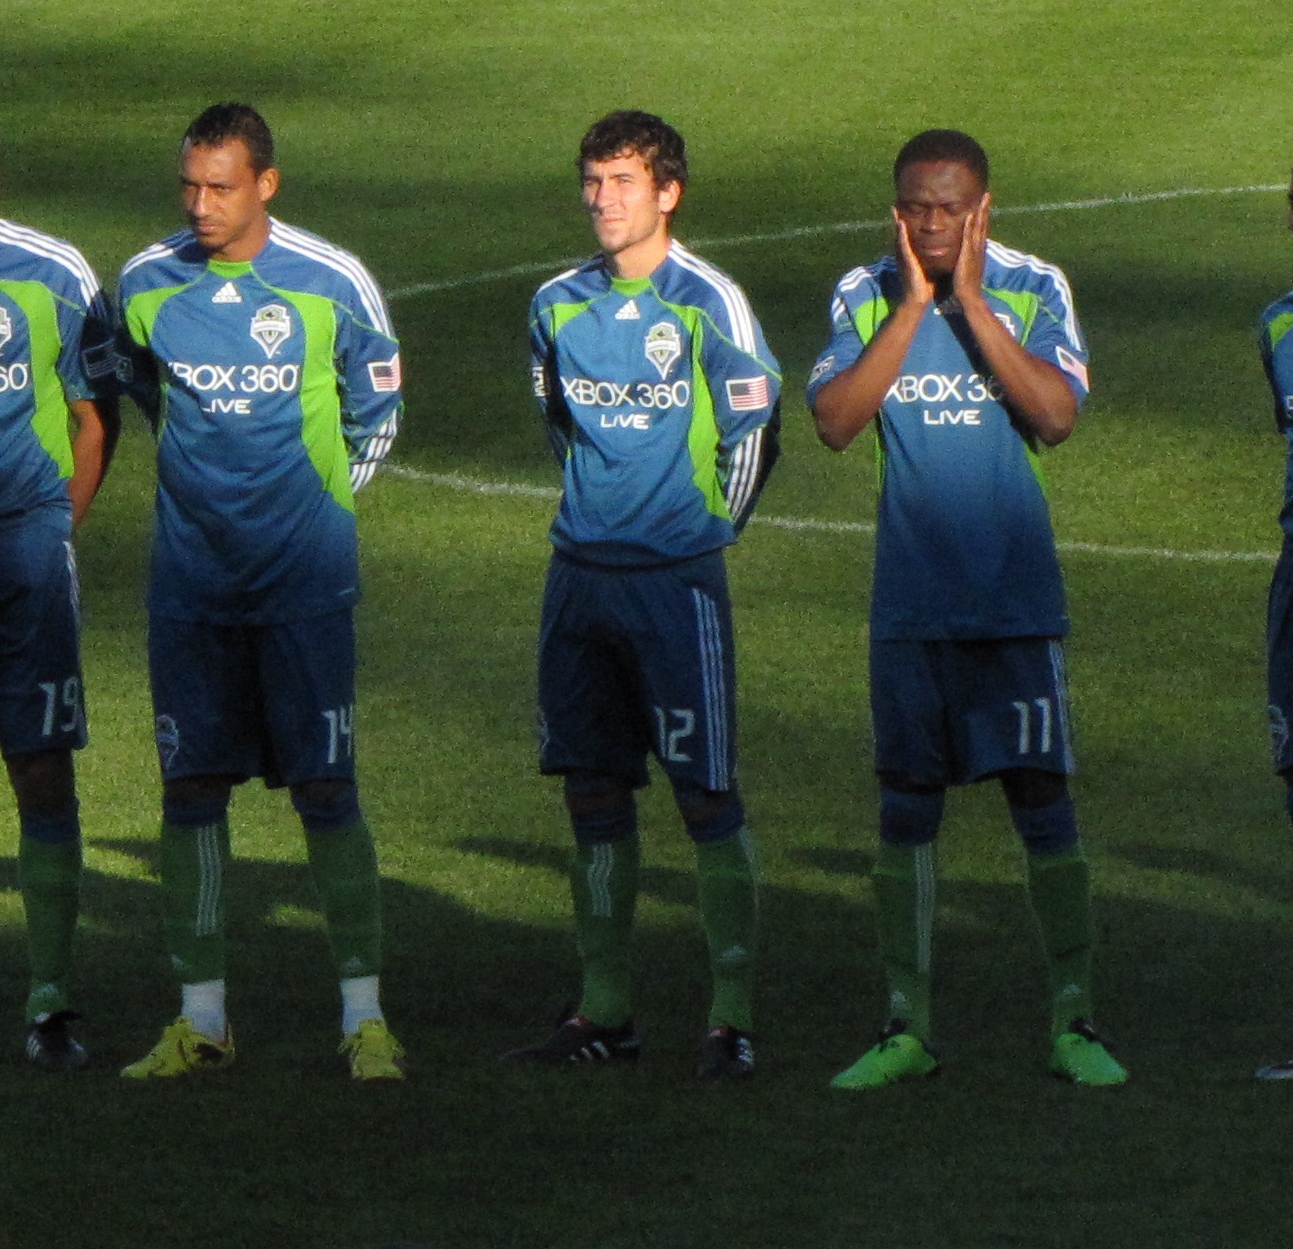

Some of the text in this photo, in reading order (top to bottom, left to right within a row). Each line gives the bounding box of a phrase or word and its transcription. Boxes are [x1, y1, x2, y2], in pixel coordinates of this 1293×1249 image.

[240, 364, 298, 393] 360
[559, 375, 636, 407] XBOX
[636, 379, 690, 410] 360
[600, 413, 650, 430] LIVE
[923, 409, 982, 425] LIVE
[37, 676, 79, 737] 19
[1011, 697, 1051, 755] 11
[320, 703, 353, 764] 14
[653, 706, 695, 762] 12
